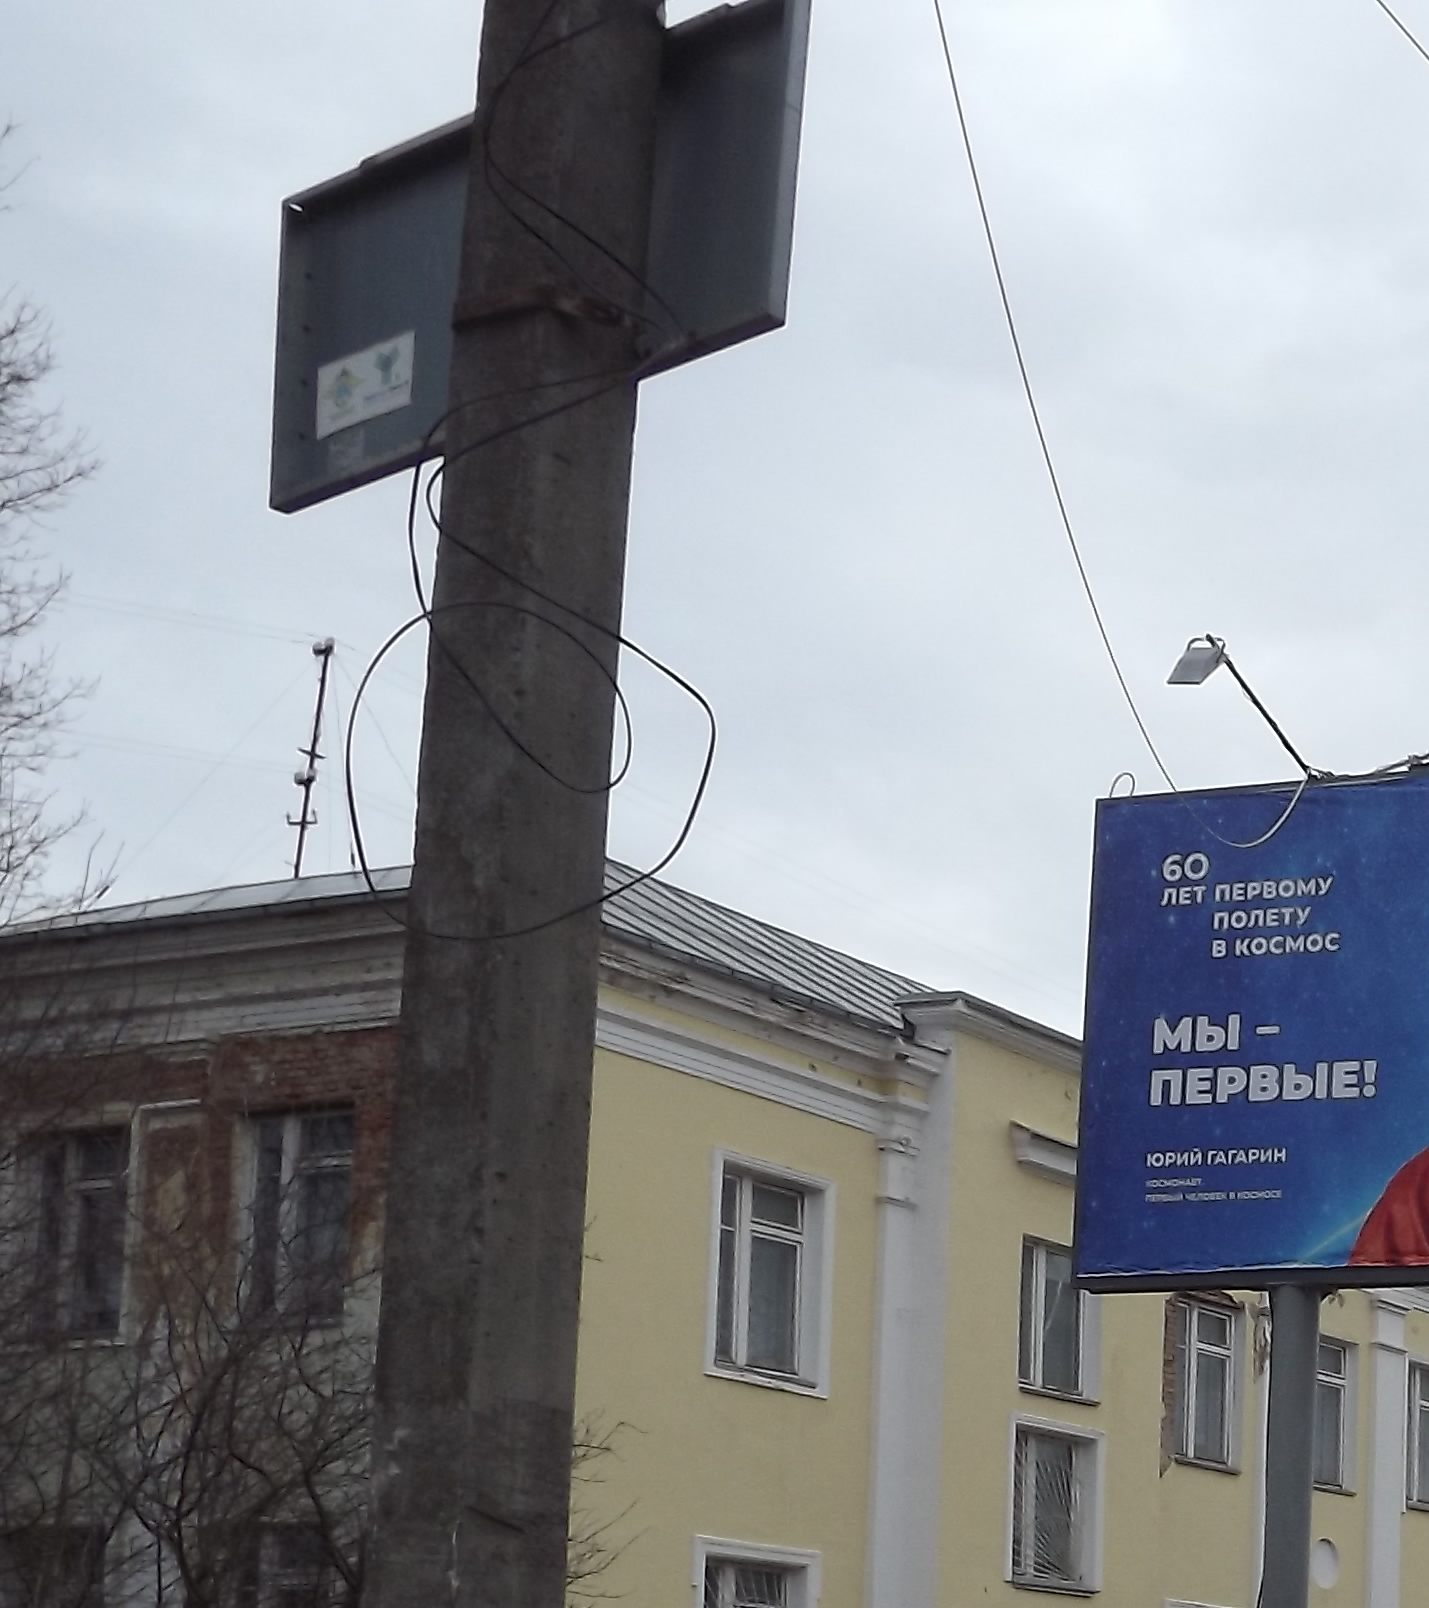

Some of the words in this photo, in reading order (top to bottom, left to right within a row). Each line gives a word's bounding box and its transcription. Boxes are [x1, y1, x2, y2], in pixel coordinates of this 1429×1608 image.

[1161, 852, 1210, 882] 60
[1160, 885, 1207, 906] ЛЕТ
[1214, 876, 1335, 903] ПЕРВОМУ
[1212, 906, 1312, 931] ПОЛЕТУ
[1211, 939, 1227, 959] В
[1234, 932, 1341, 957] КОСМОС
[1152, 1013, 1241, 1055] МЫ
[1149, 1060, 1378, 1107] ПЕРВЫЕ!
[1146, 1148, 1202, 1168] ЮРИЙ
[1206, 1147, 1287, 1166] ГАГАРИН
